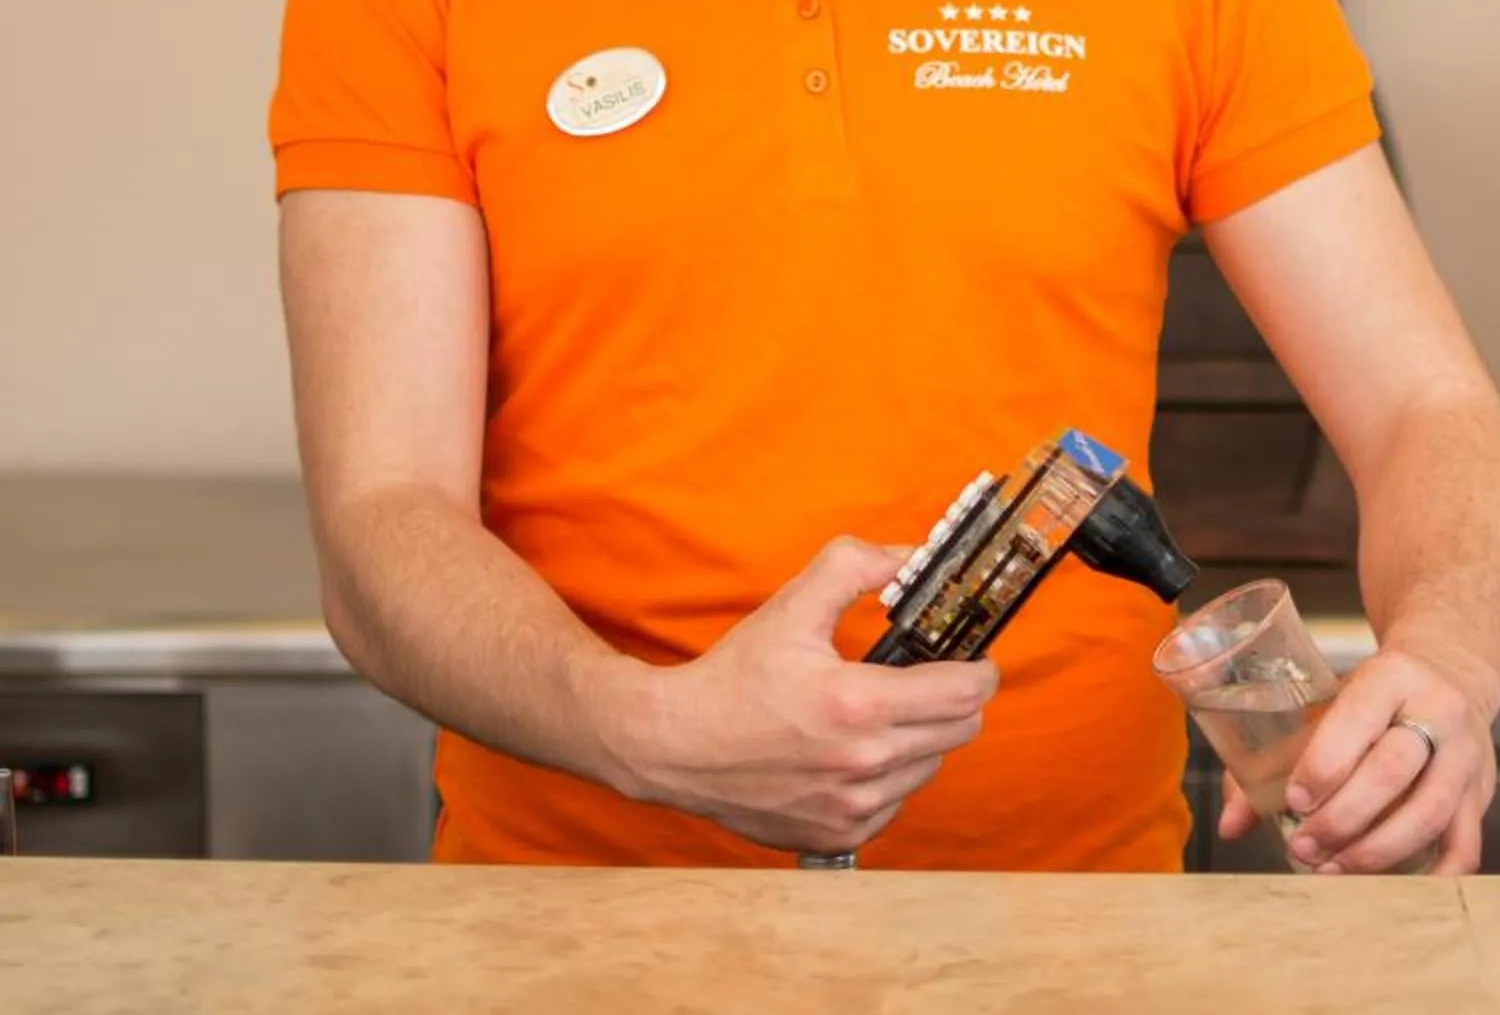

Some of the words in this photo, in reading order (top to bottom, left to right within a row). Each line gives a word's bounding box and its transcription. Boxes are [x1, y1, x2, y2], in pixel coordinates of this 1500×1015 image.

[888, 29, 1086, 58] SOVEREIGN
[914, 60, 995, 89] Beach
[1000, 61, 1070, 92] Hotel
[581, 81, 646, 118] VASILIS
